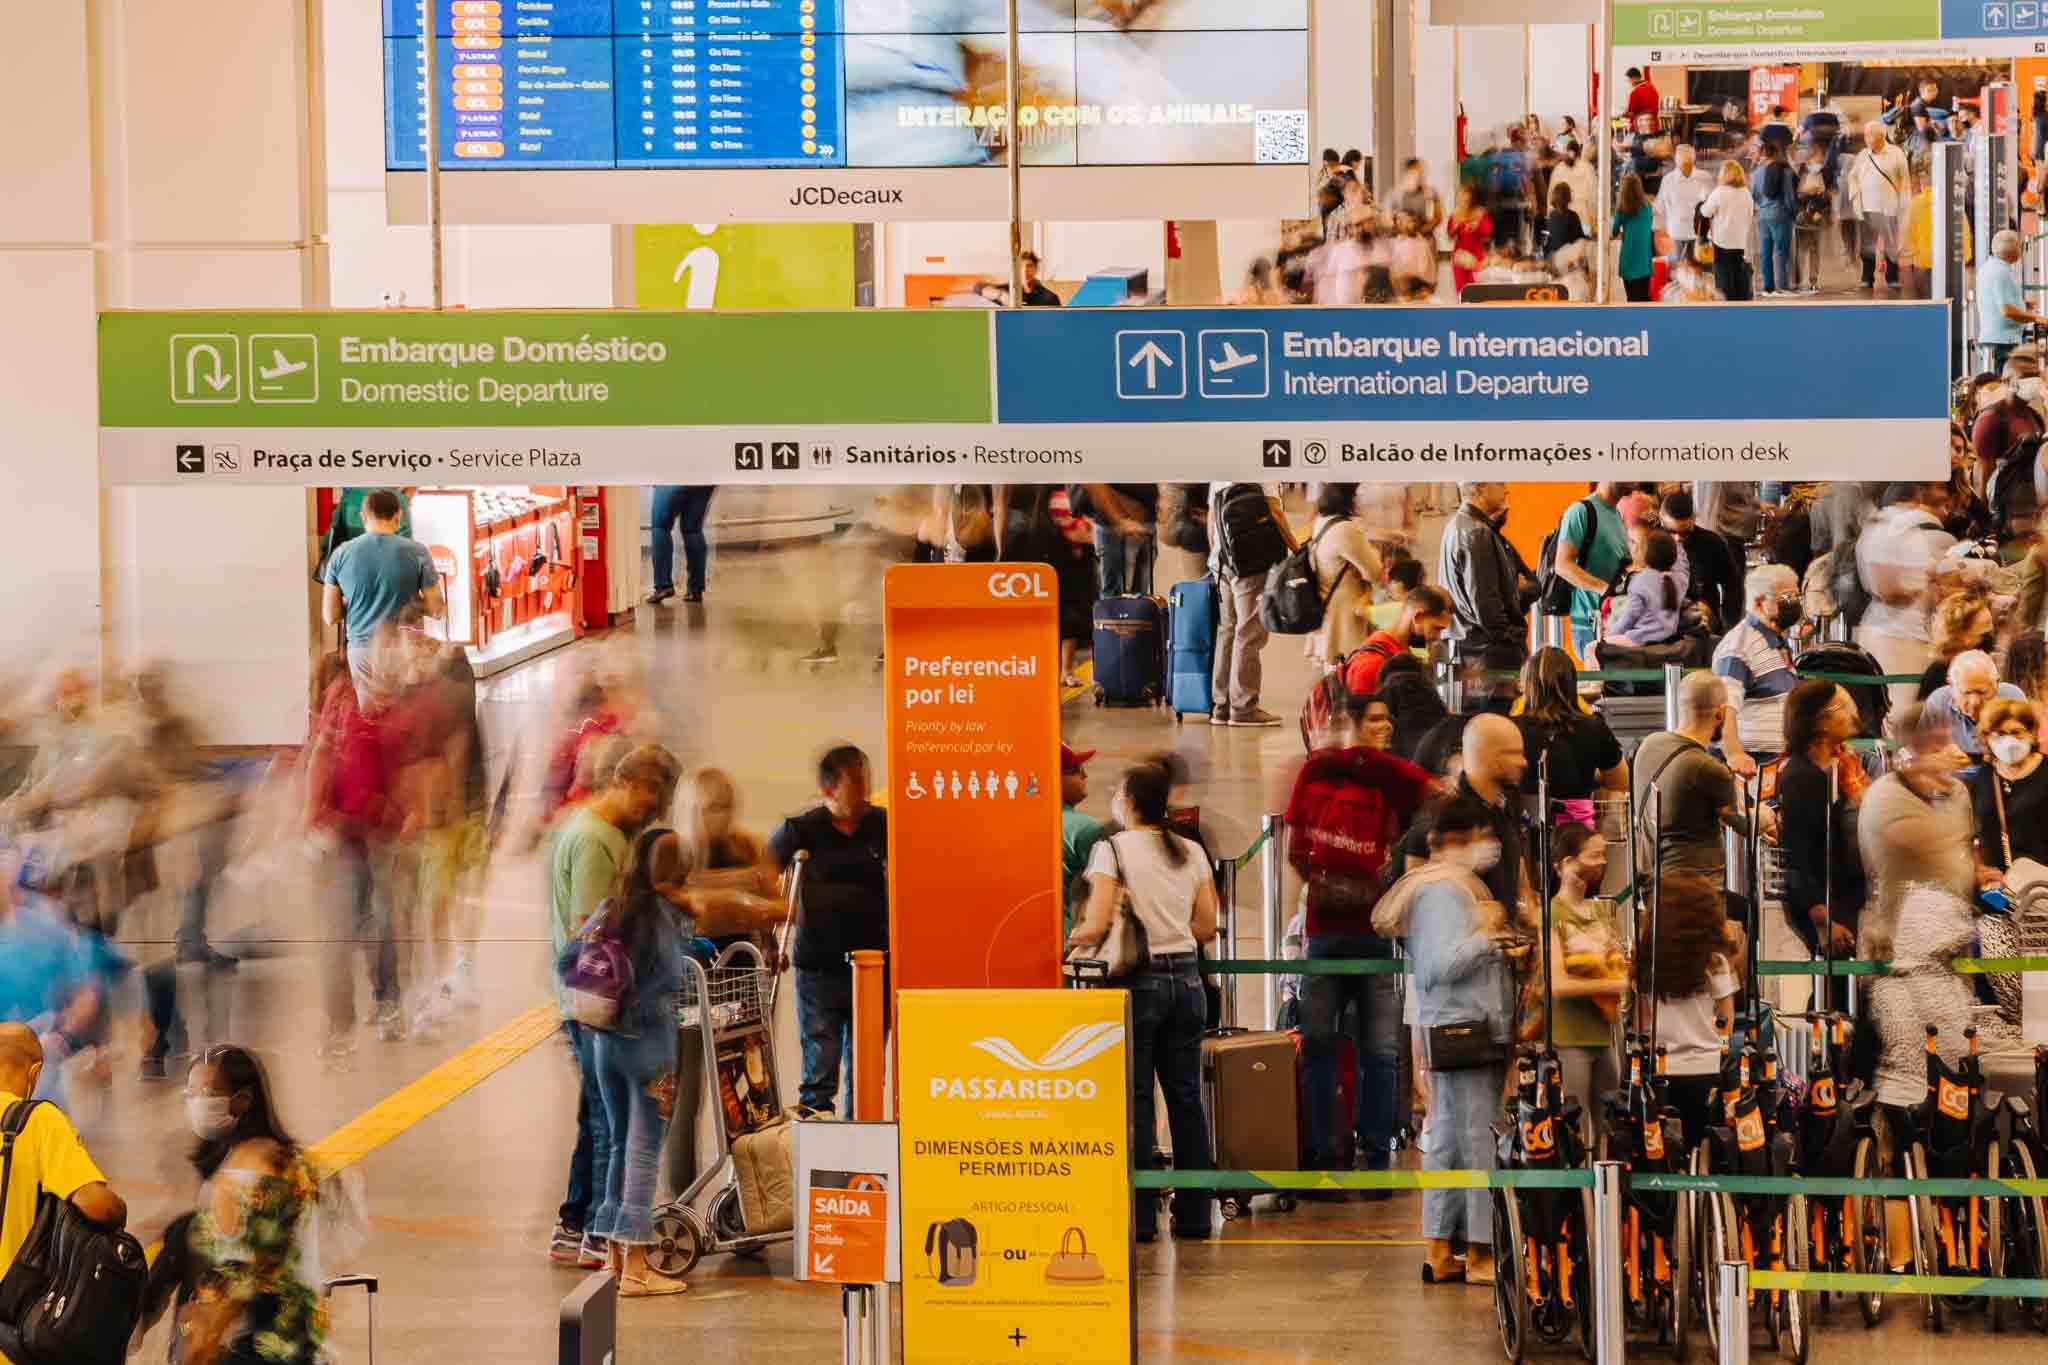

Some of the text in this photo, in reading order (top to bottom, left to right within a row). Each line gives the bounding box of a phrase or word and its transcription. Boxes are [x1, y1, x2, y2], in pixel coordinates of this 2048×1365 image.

[897, 104, 1039, 131] INTERAÇO
[790, 187, 903, 205] JCDecaux
[340, 334, 666, 368] Embarque Doméstico
[1284, 330, 1648, 363] Embarque Internacional
[341, 378, 608, 407] Domestic Departure
[1285, 370, 1589, 400] International Departure
[254, 448, 580, 472] Praça de Serviço Service Plaza
[847, 446, 1082, 464] Sanitários Restrooms
[1342, 442, 1788, 465] Balcão de Informações Information desk
[988, 573, 1048, 597] GOL
[906, 656, 1036, 676] Preferencial
[906, 684, 974, 708] por lei
[905, 720, 949, 735] Priority
[931, 1078, 1097, 1099] PASSAREDO
[914, 1138, 1115, 1156] DIMENSÕES MÁXIMAS
[960, 1162, 1071, 1176] PERMITIDAS
[816, 1195, 870, 1216] SAÍDA
[972, 1201, 1071, 1214] ARTIGO PESSOAL
[1004, 1249, 1026, 1260] ou
